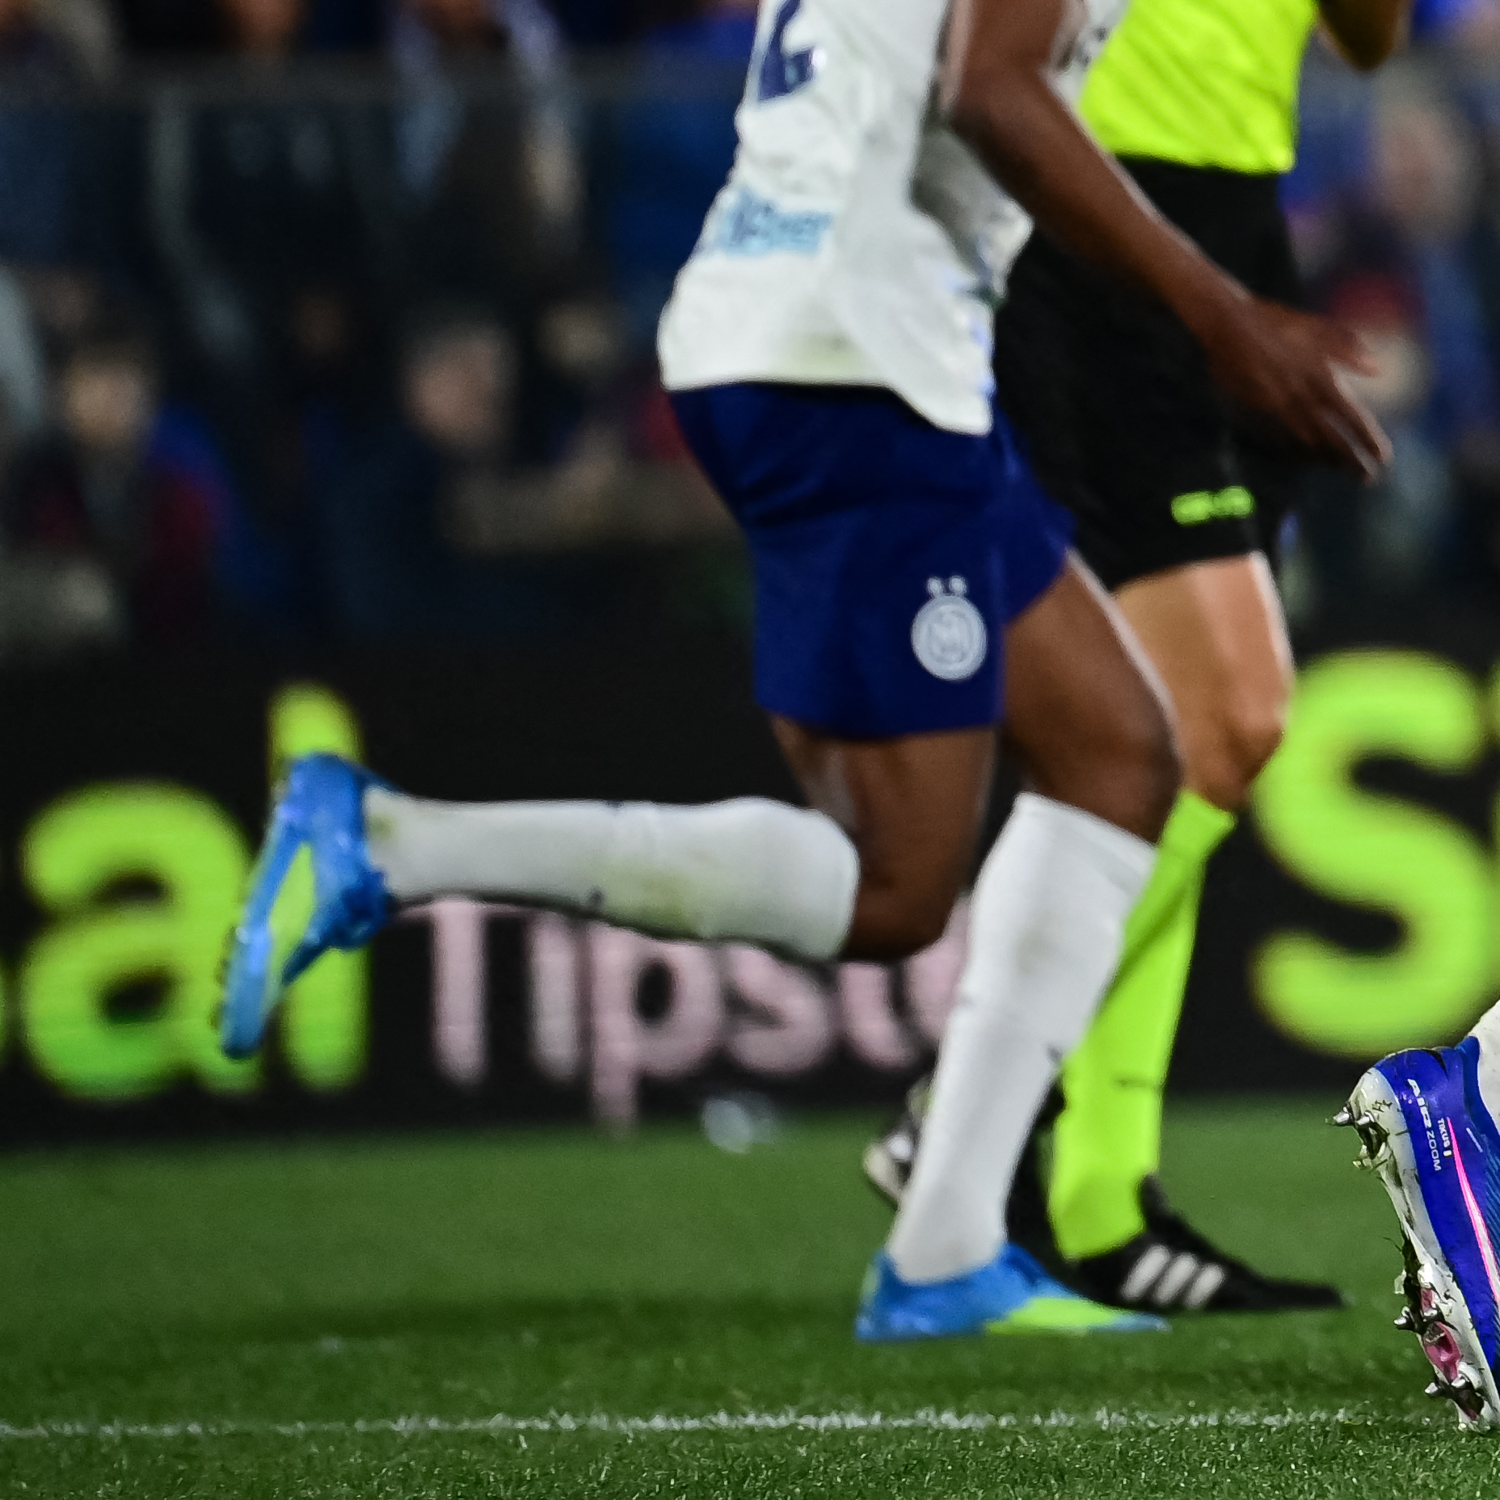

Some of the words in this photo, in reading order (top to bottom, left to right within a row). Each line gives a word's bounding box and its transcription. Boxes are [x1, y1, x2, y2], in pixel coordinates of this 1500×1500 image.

[0, 682, 368, 1098] al
[1407, 1078, 1432, 1128] AIR
[1426, 1130, 1442, 1171] ZOOM
